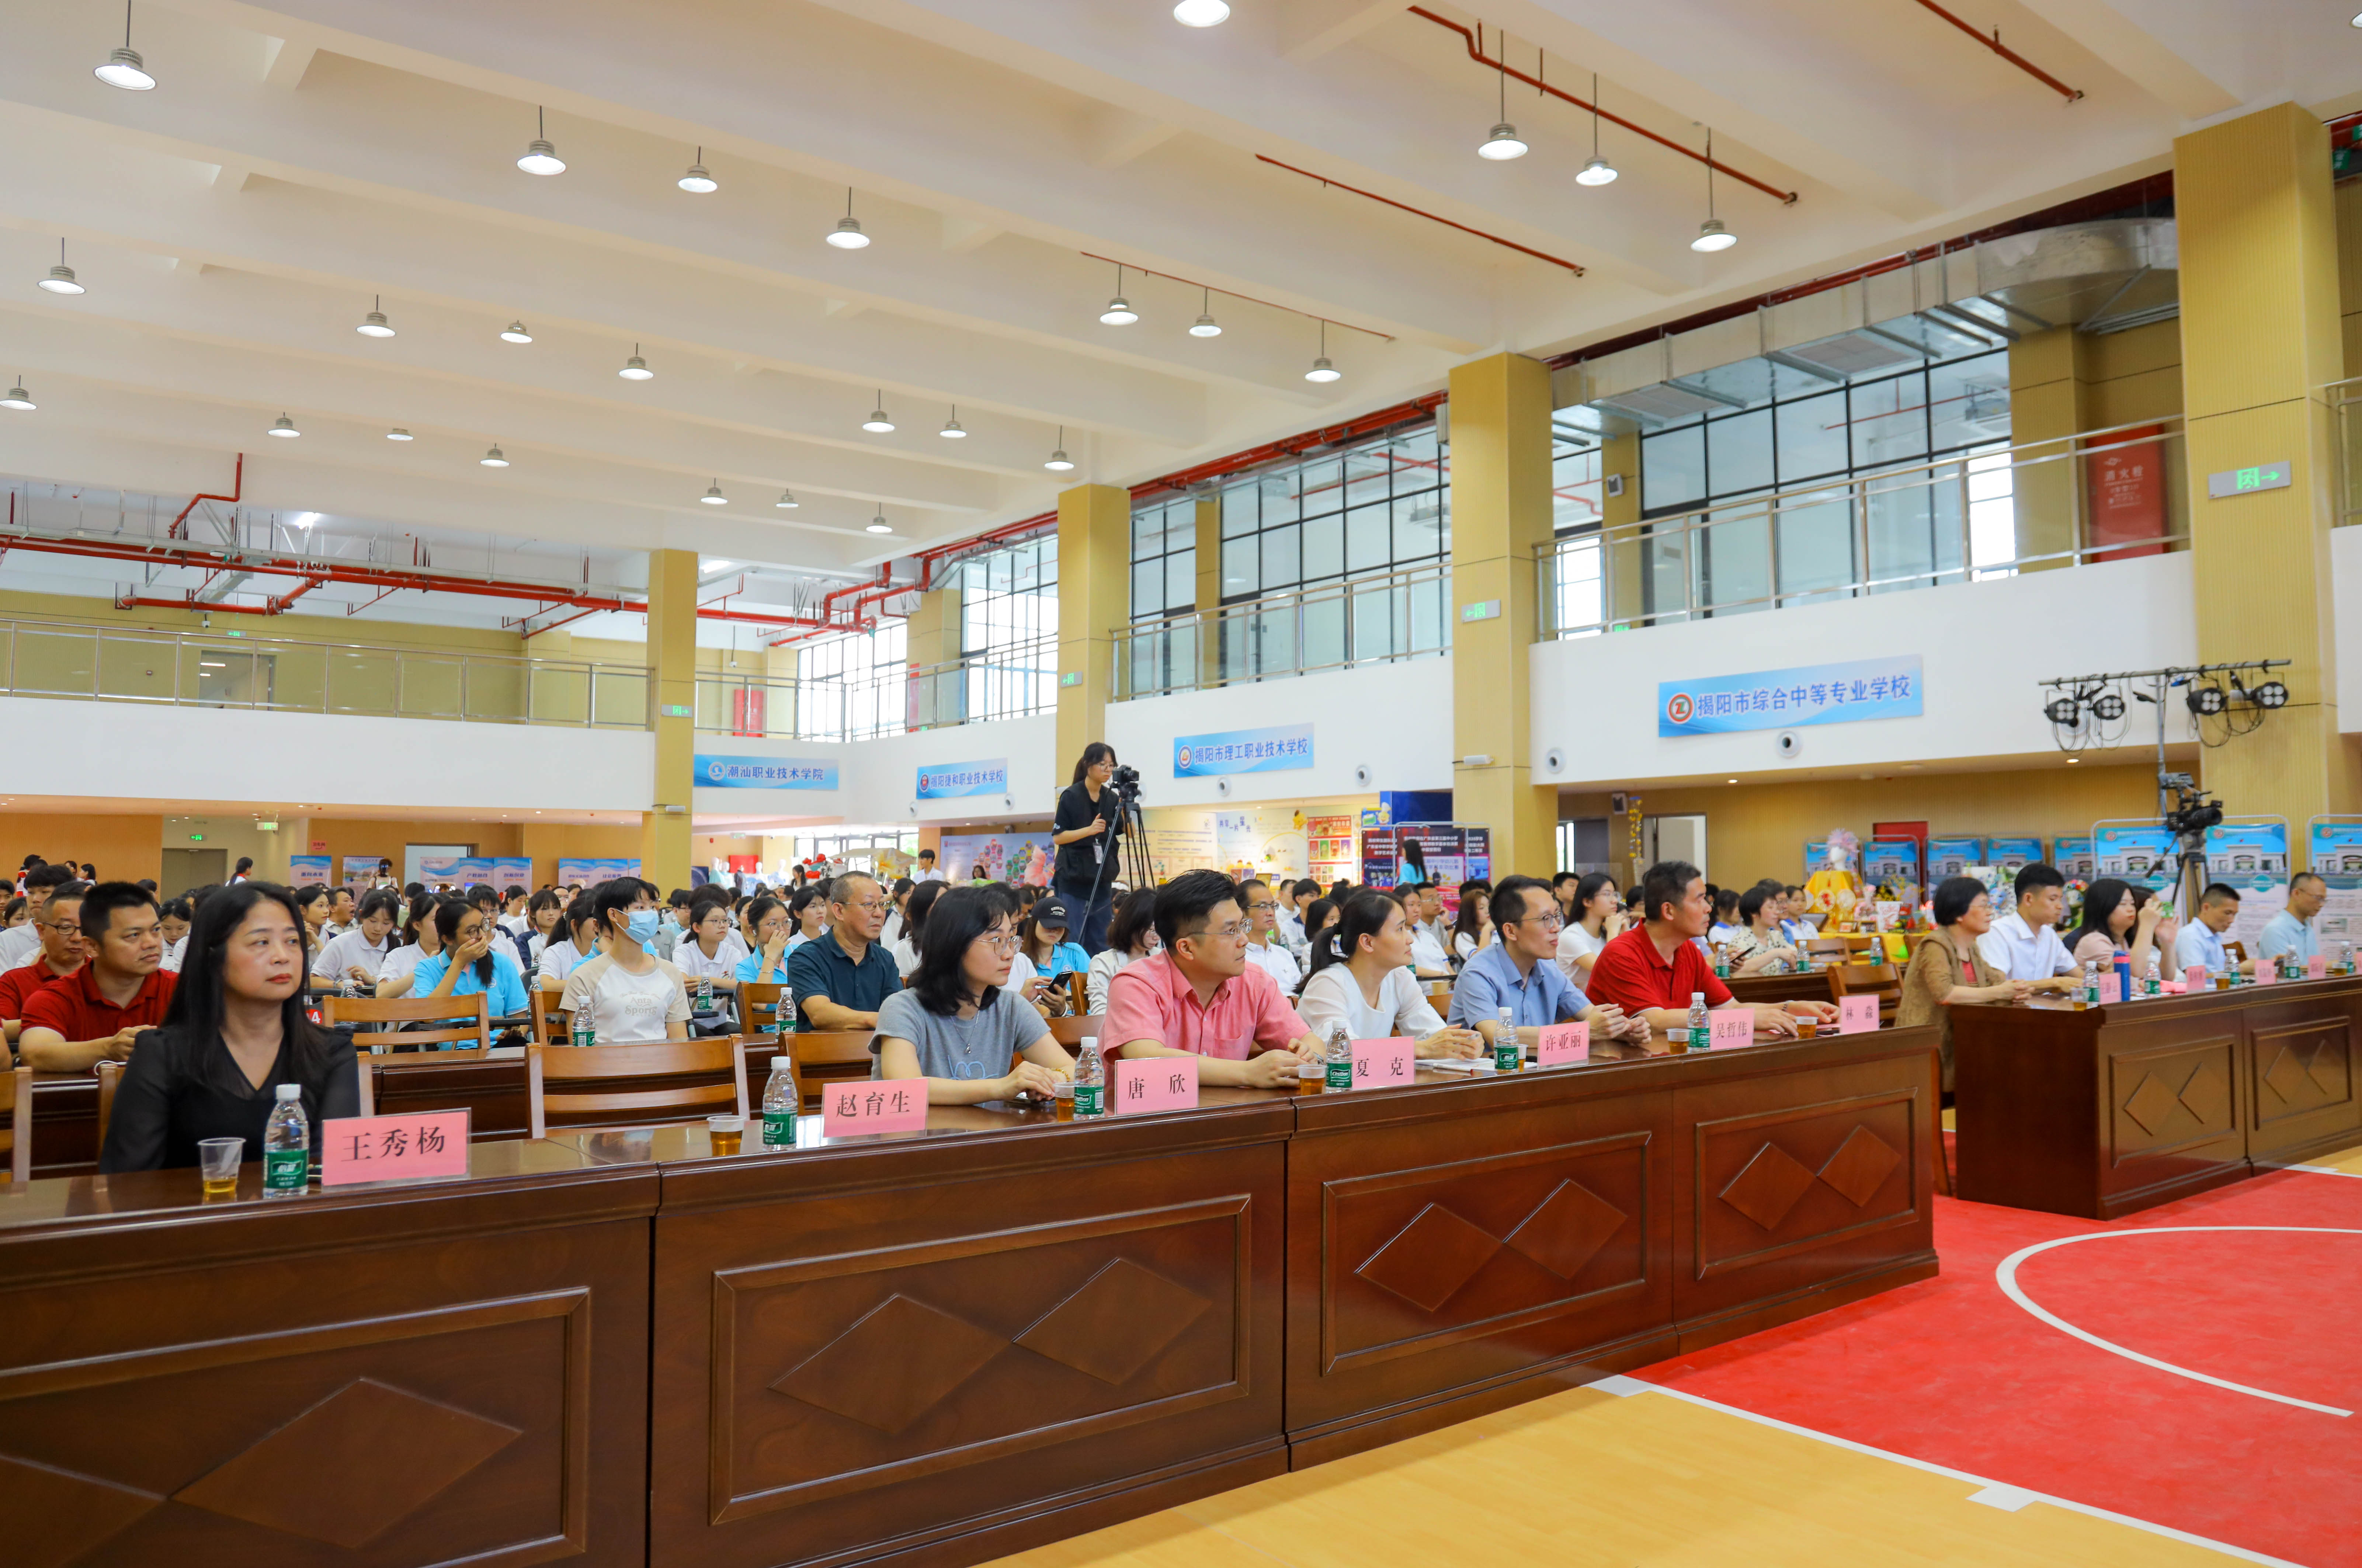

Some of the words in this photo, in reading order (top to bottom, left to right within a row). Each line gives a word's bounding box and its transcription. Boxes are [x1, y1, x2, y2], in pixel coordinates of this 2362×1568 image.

[1698, 674, 1910, 717] 揭阳市综合中等专业学校
[1195, 737, 1308, 764] 揭阳市理工职业技术学校
[727, 765, 823, 780] 潮汕职业技术学院
[931, 769, 1003, 788] 揭阳捷和职业技术学校
[625, 1005, 658, 1016] Sports
[631, 997, 652, 1005] Anta
[1716, 1021, 1748, 1039] 吴哲伟
[1546, 1030, 1581, 1052] 许亚丽
[1355, 1057, 1404, 1077] 夏克
[1128, 1074, 1186, 1100] 唐欣
[835, 1090, 910, 1118] 赵育生
[341, 1126, 445, 1162] 王秀杨
